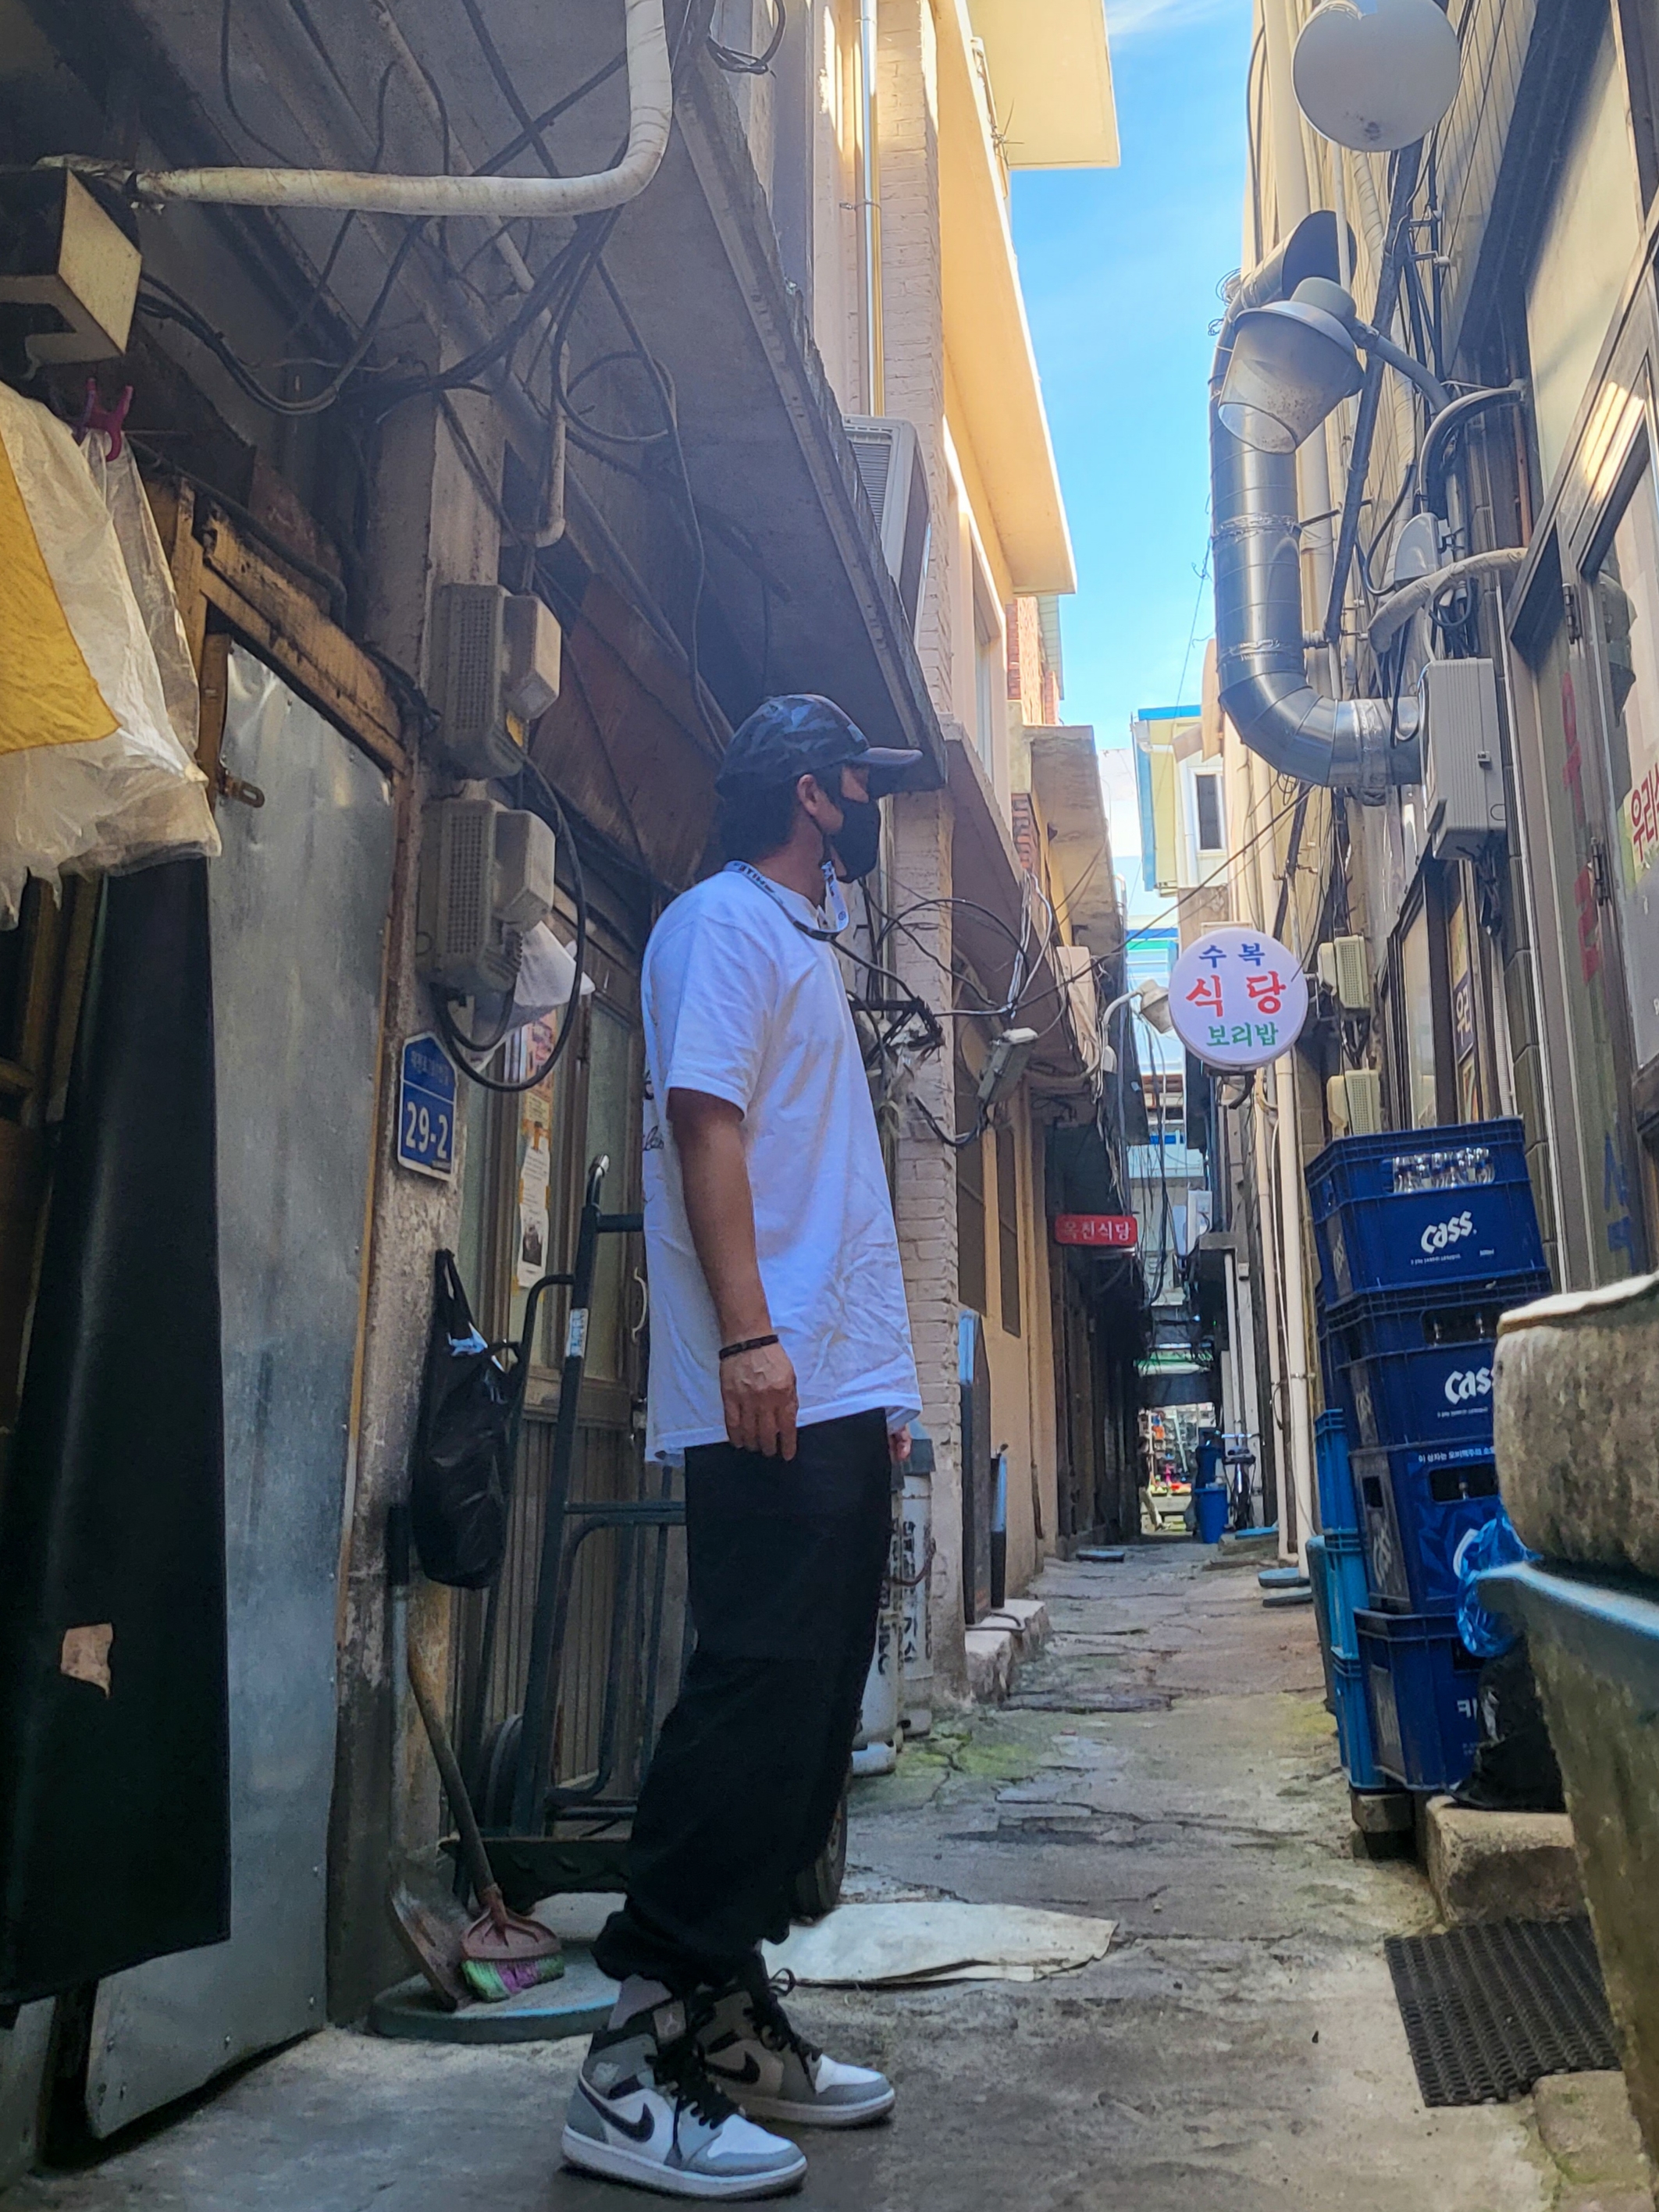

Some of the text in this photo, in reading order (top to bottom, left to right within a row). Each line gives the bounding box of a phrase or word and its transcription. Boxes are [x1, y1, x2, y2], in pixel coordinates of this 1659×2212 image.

[1198, 943, 1266, 968] 수복
[1185, 970, 1287, 1017] 식당
[1206, 1021, 1279, 1047] 보리밥
[405, 1101, 448, 1160] 29-2
[1420, 1211, 1473, 1254] Cass
[1444, 1367, 1493, 1405] Cas
